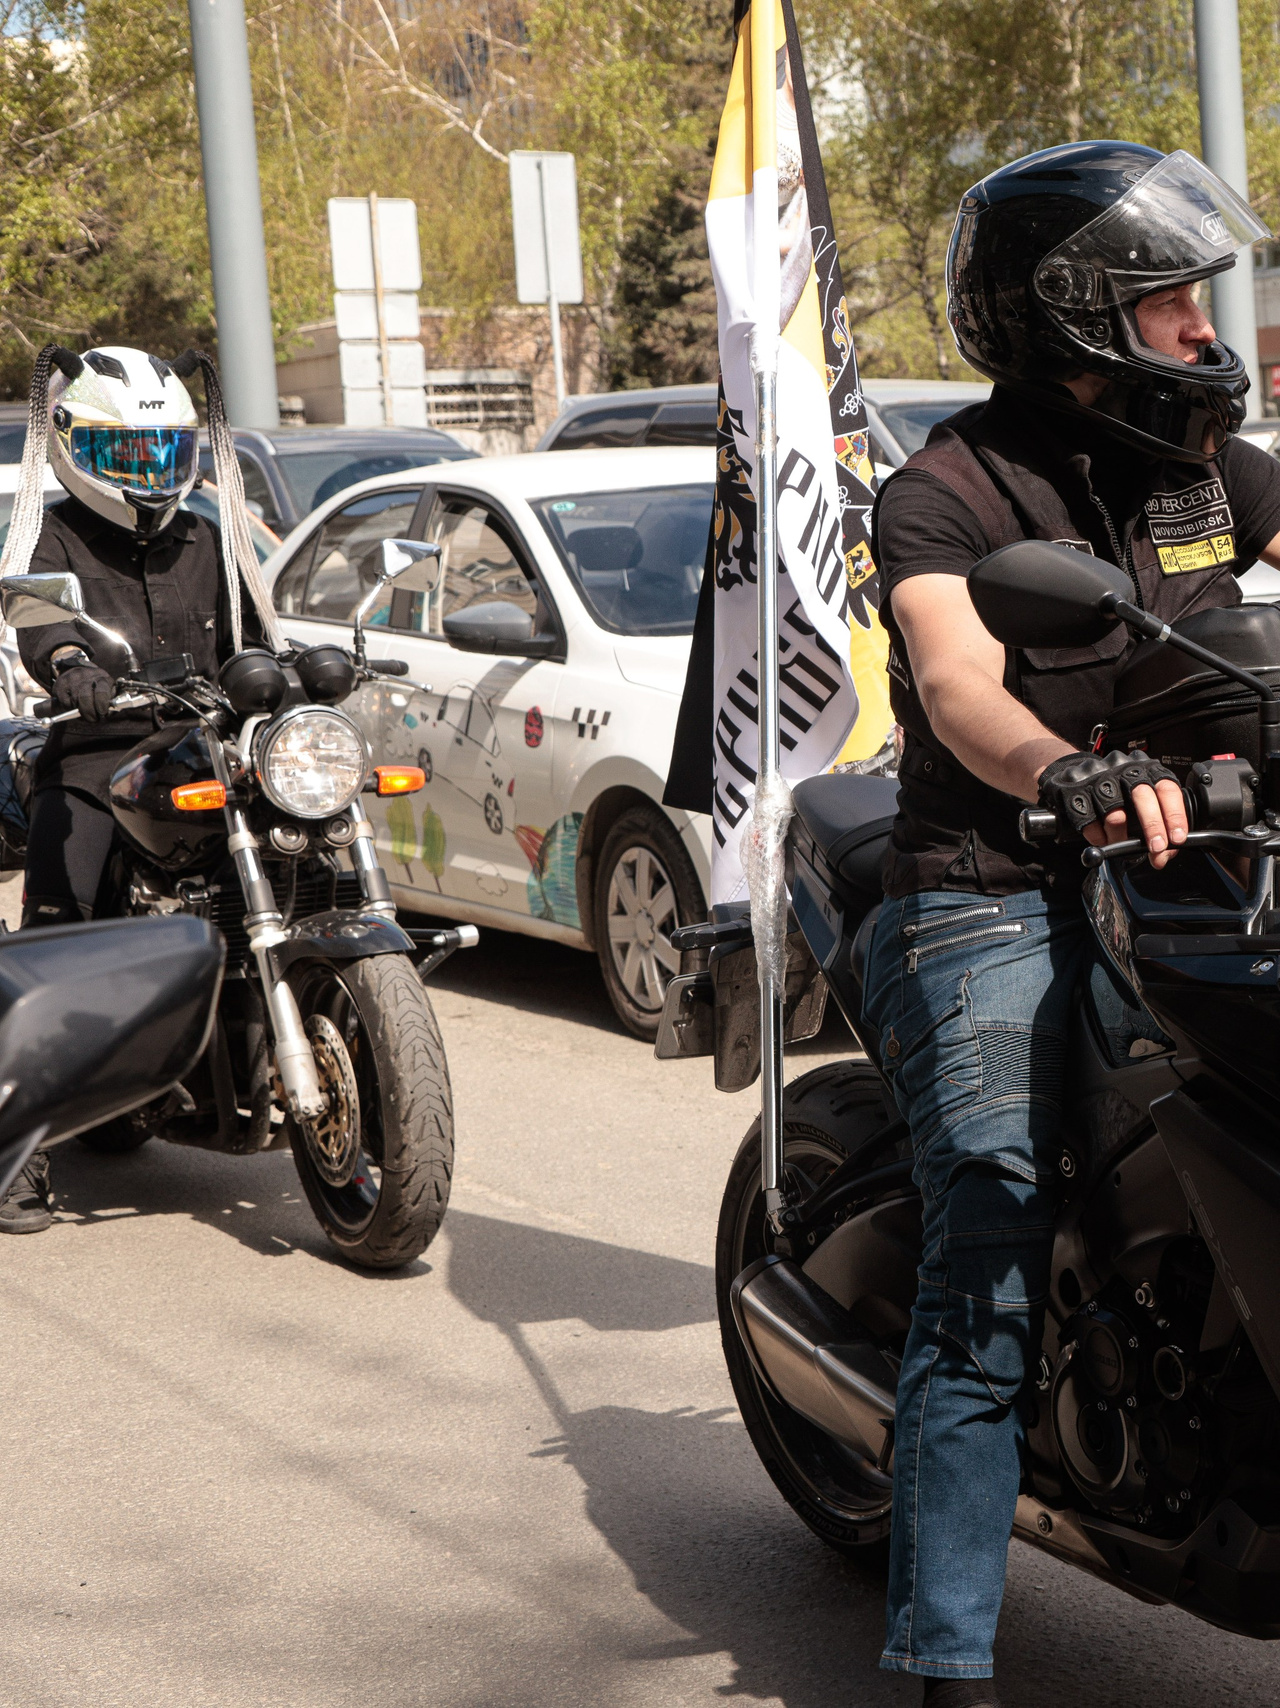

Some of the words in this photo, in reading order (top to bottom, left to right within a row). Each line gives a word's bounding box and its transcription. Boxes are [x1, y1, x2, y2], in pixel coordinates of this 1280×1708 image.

[139, 400, 165, 410] MT
[1146, 499, 1159, 512] 99
[1161, 484, 1219, 513] PERCENT
[1153, 513, 1226, 538] NOVOSIBIRSK
[1216, 537, 1230, 549] 54
[1218, 550, 1232, 559] RUS
[799, 1125, 843, 1151] MICHELIN
